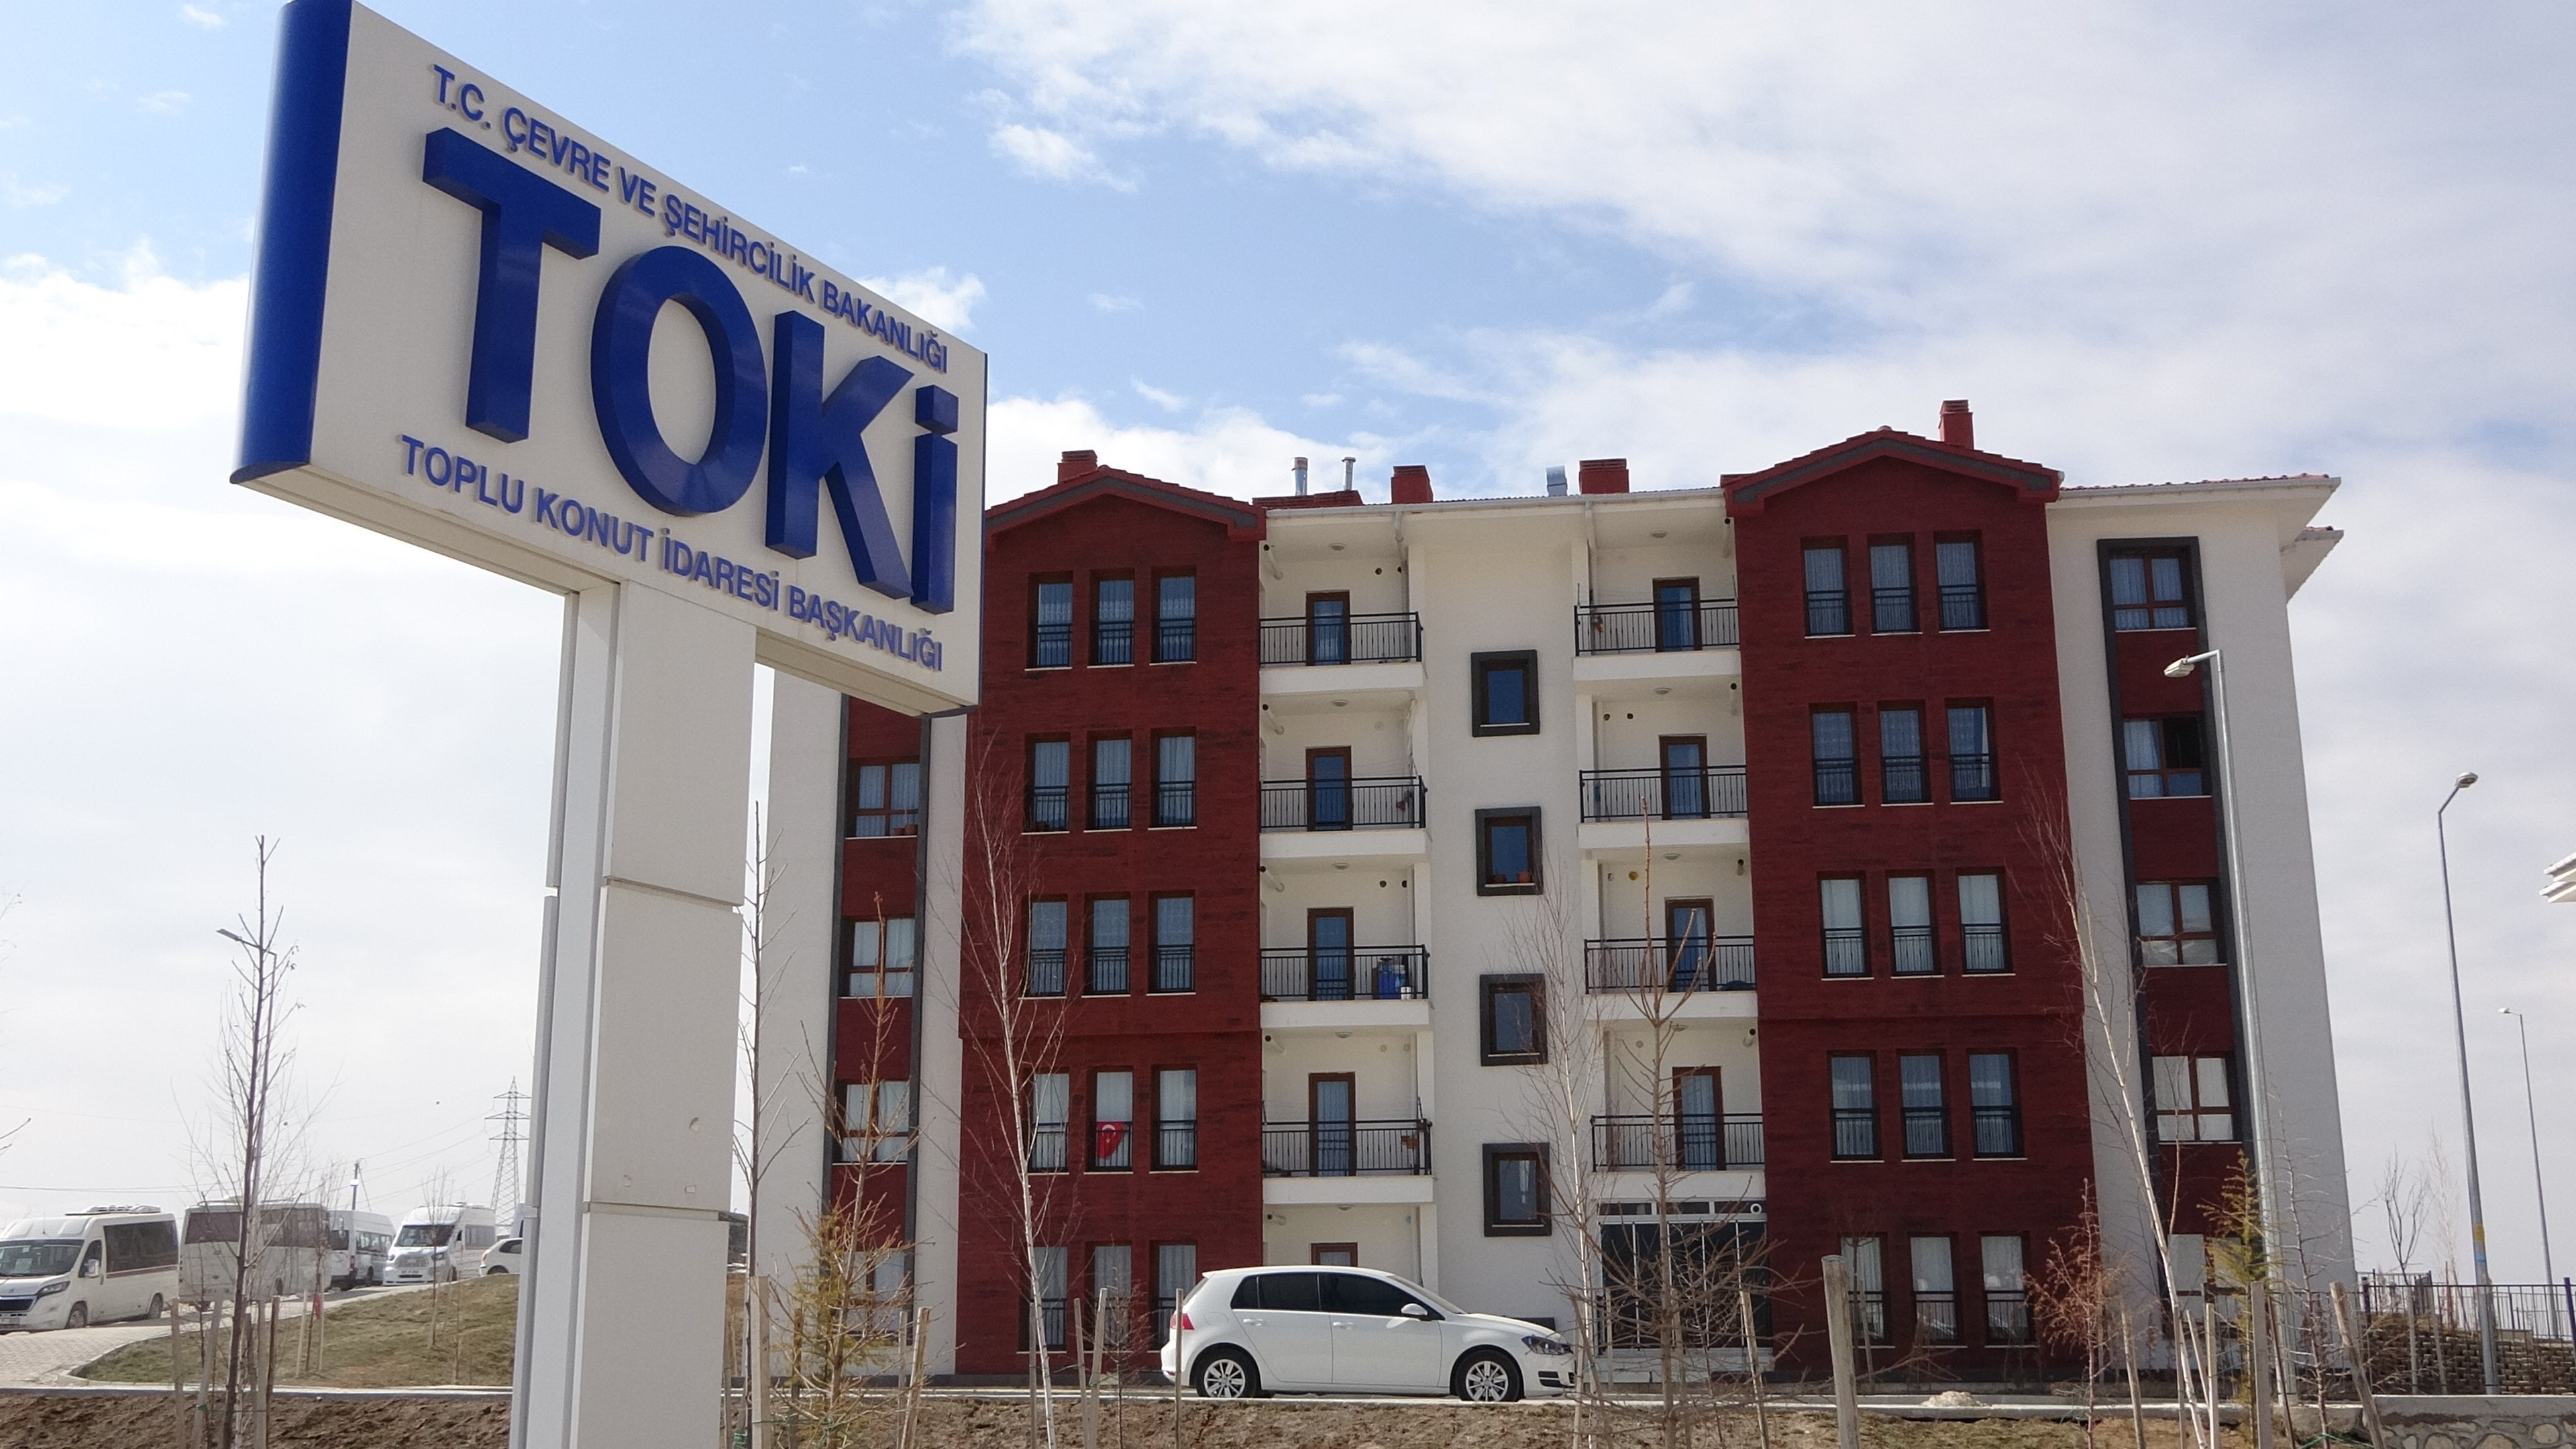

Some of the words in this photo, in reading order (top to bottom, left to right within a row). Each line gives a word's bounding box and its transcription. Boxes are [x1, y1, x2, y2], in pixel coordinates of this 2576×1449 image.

[433, 64, 491, 129] T.C.
[503, 107, 611, 192] ÇEVRE
[620, 167, 656, 217] VE
[664, 194, 816, 302] ŞEHİRCİLİK
[823, 280, 947, 374] BAKANLIĞI
[400, 434, 524, 514] TOPLU
[535, 487, 653, 562] KONUT
[661, 527, 780, 610] İDARESİ
[789, 585, 942, 672] BAŞKANLIĞI
